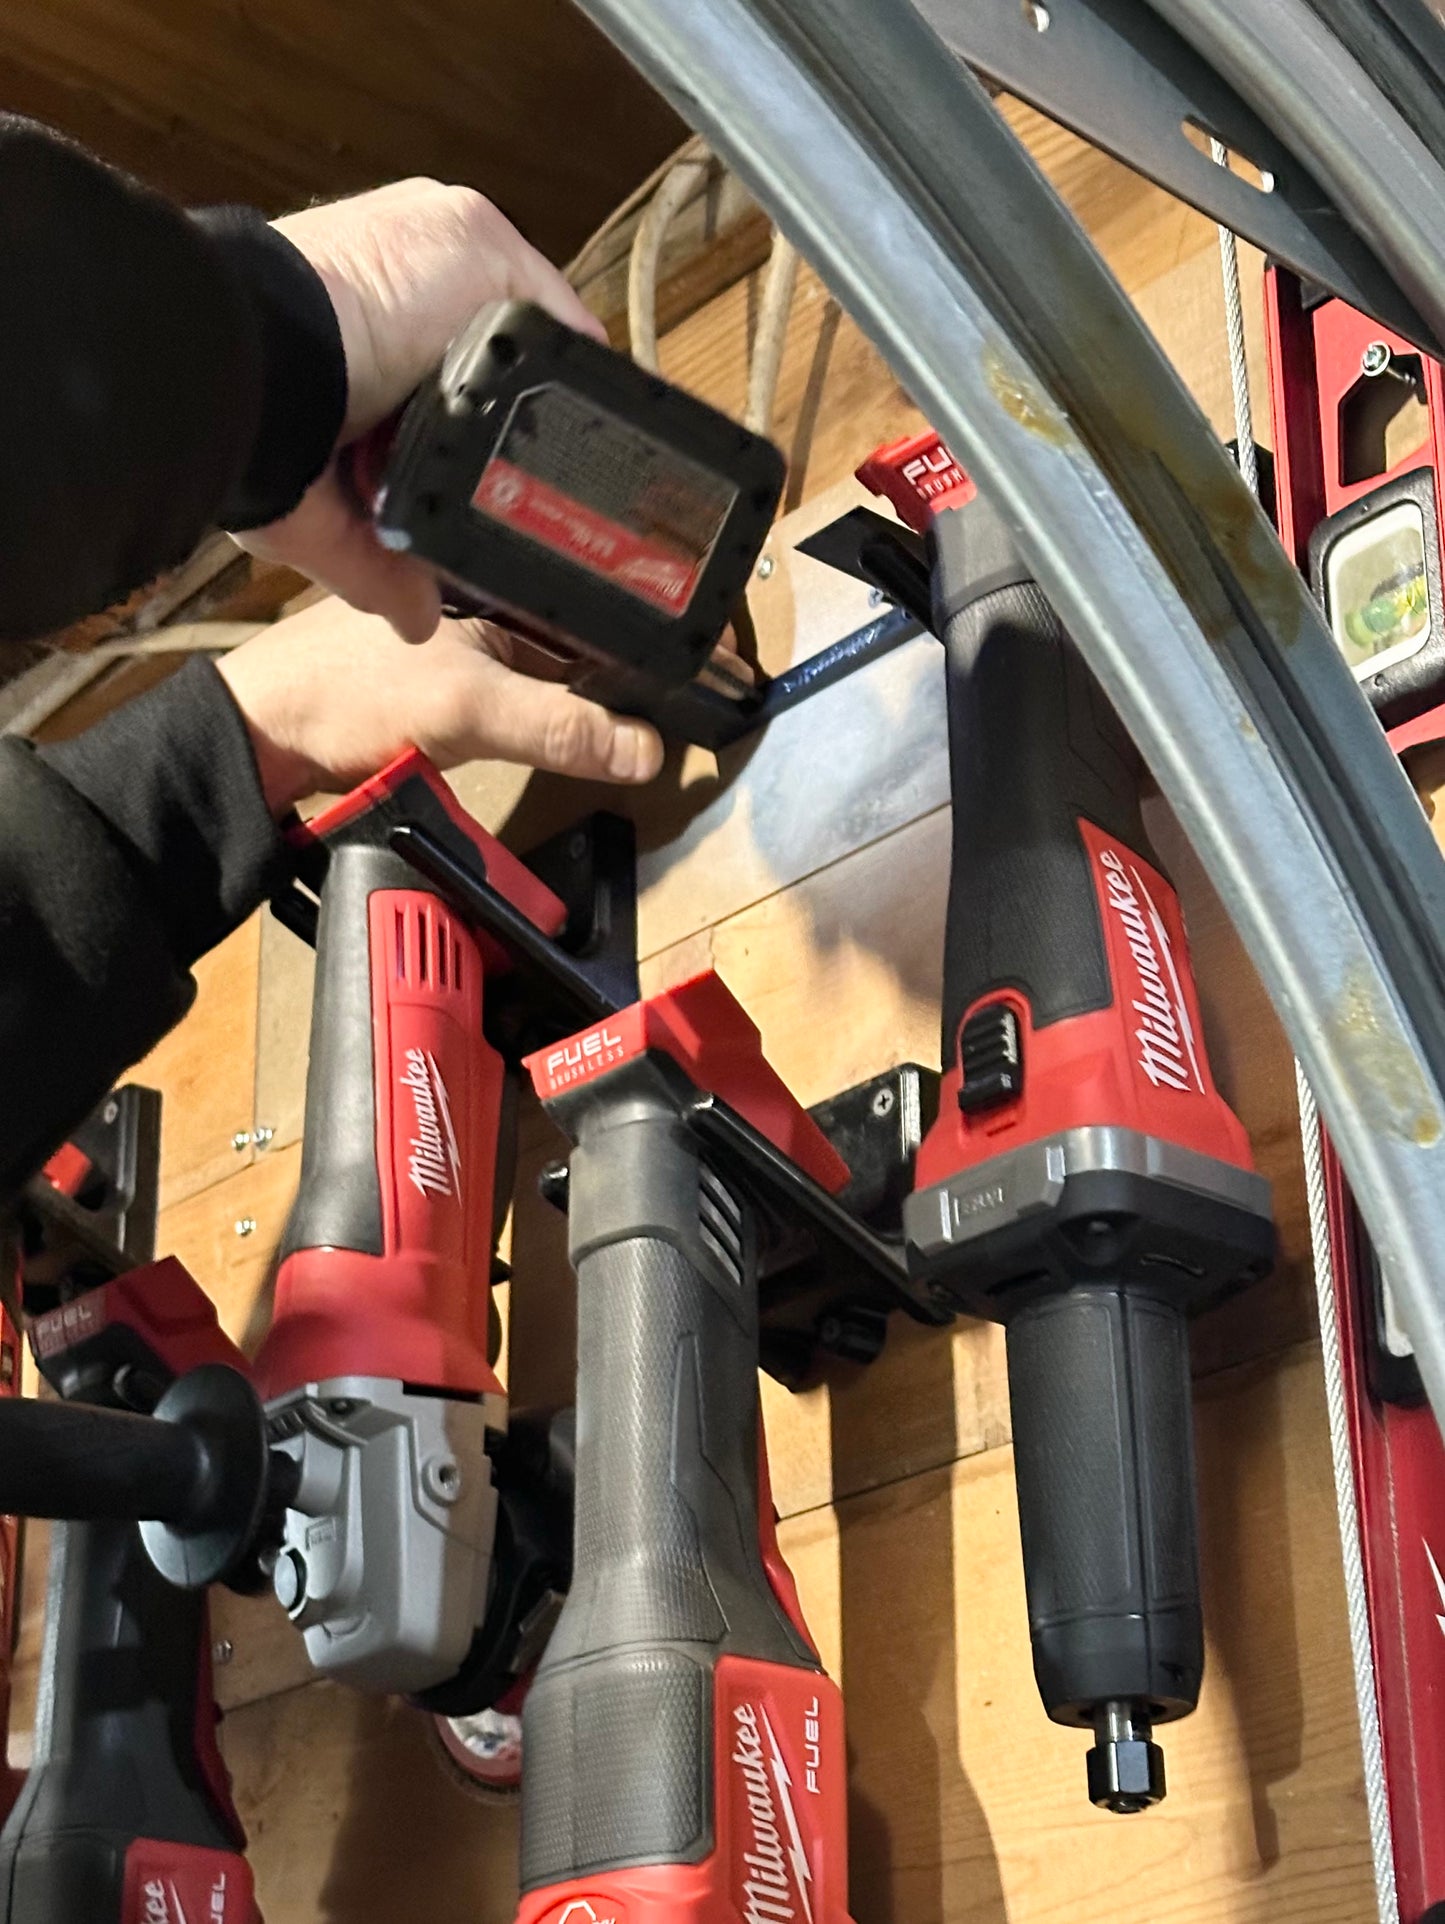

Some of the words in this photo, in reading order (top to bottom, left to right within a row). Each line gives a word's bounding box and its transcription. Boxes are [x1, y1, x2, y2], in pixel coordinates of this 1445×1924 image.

[902, 446, 953, 486] FU
[916, 468, 964, 500] BRUSH
[1100, 849, 1192, 1091] Milwaukee
[547, 1028, 622, 1076] FUEL
[550, 1045, 624, 1091] BRUSHLESS
[400, 1048, 452, 1197] Milwaukee
[36, 1304, 92, 1336] FUEL
[805, 1696, 820, 1794] FUEL
[732, 1703, 795, 1924] Milwaukee
